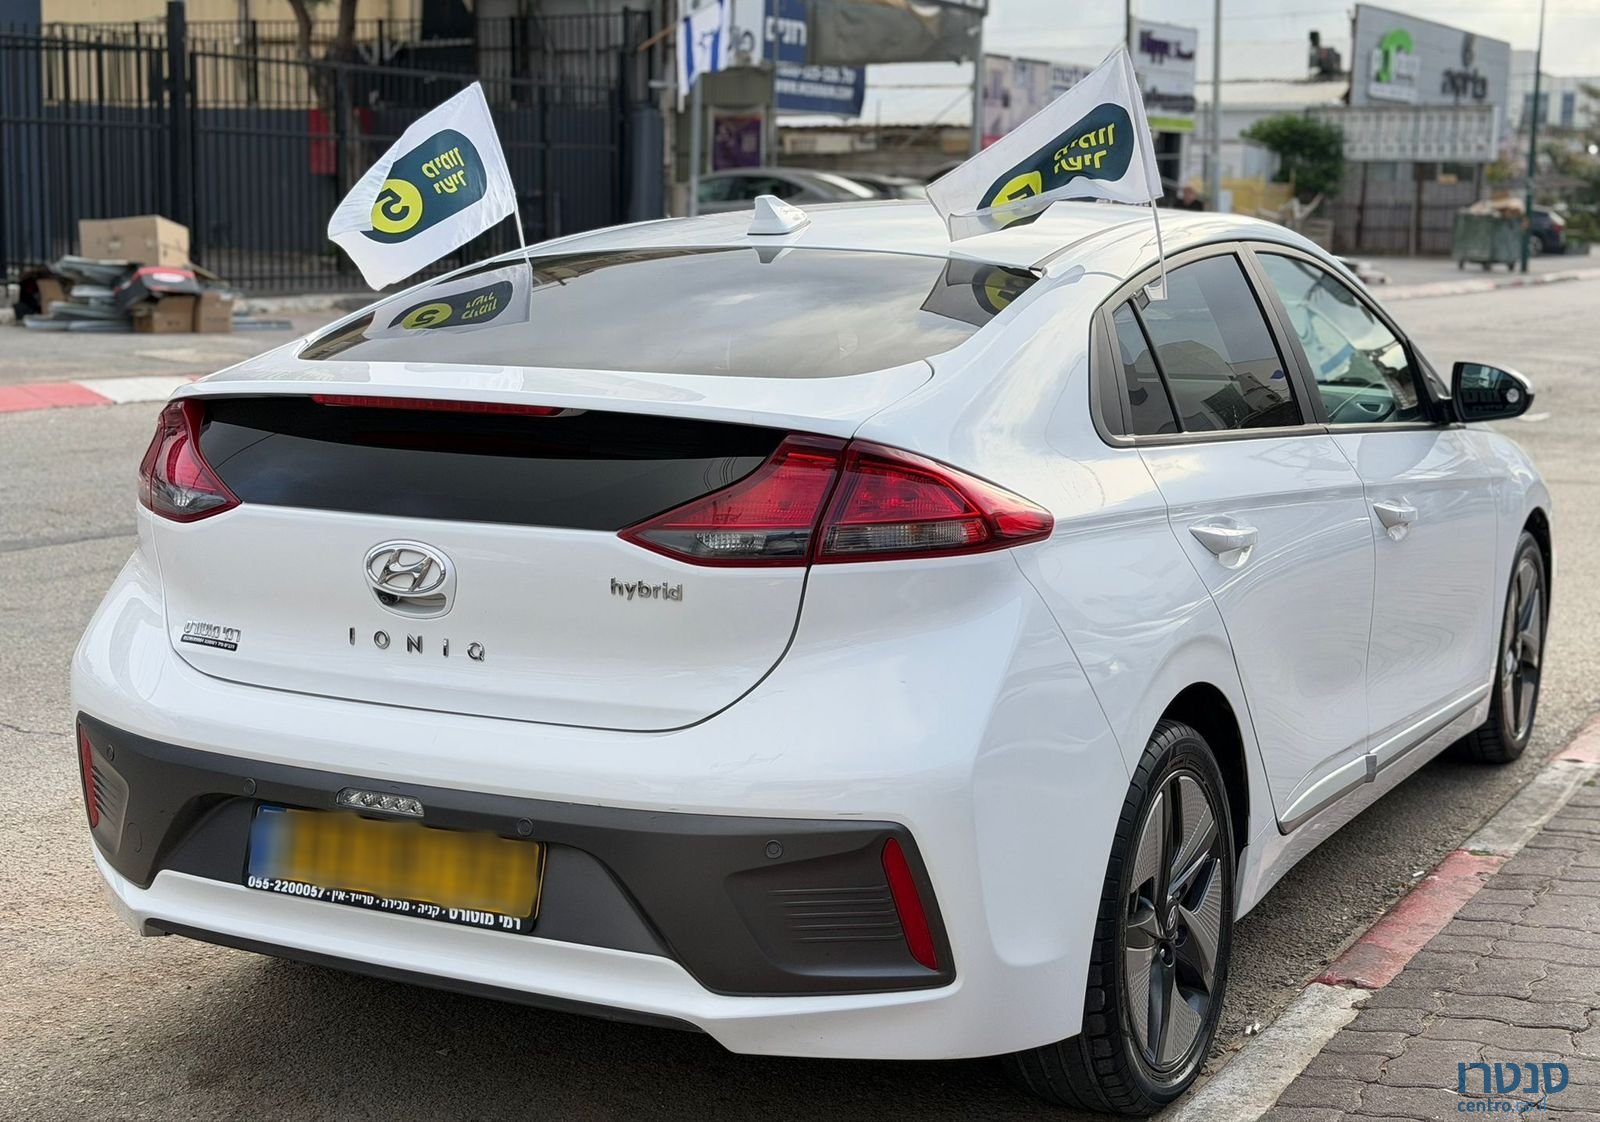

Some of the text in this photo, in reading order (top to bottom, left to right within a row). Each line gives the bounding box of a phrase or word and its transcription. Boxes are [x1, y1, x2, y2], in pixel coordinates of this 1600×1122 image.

[610, 577, 683, 601] hybrid
[248, 875, 521, 930] רמי מוטורס קניה מכירה טרייד-אין 055-2200057
